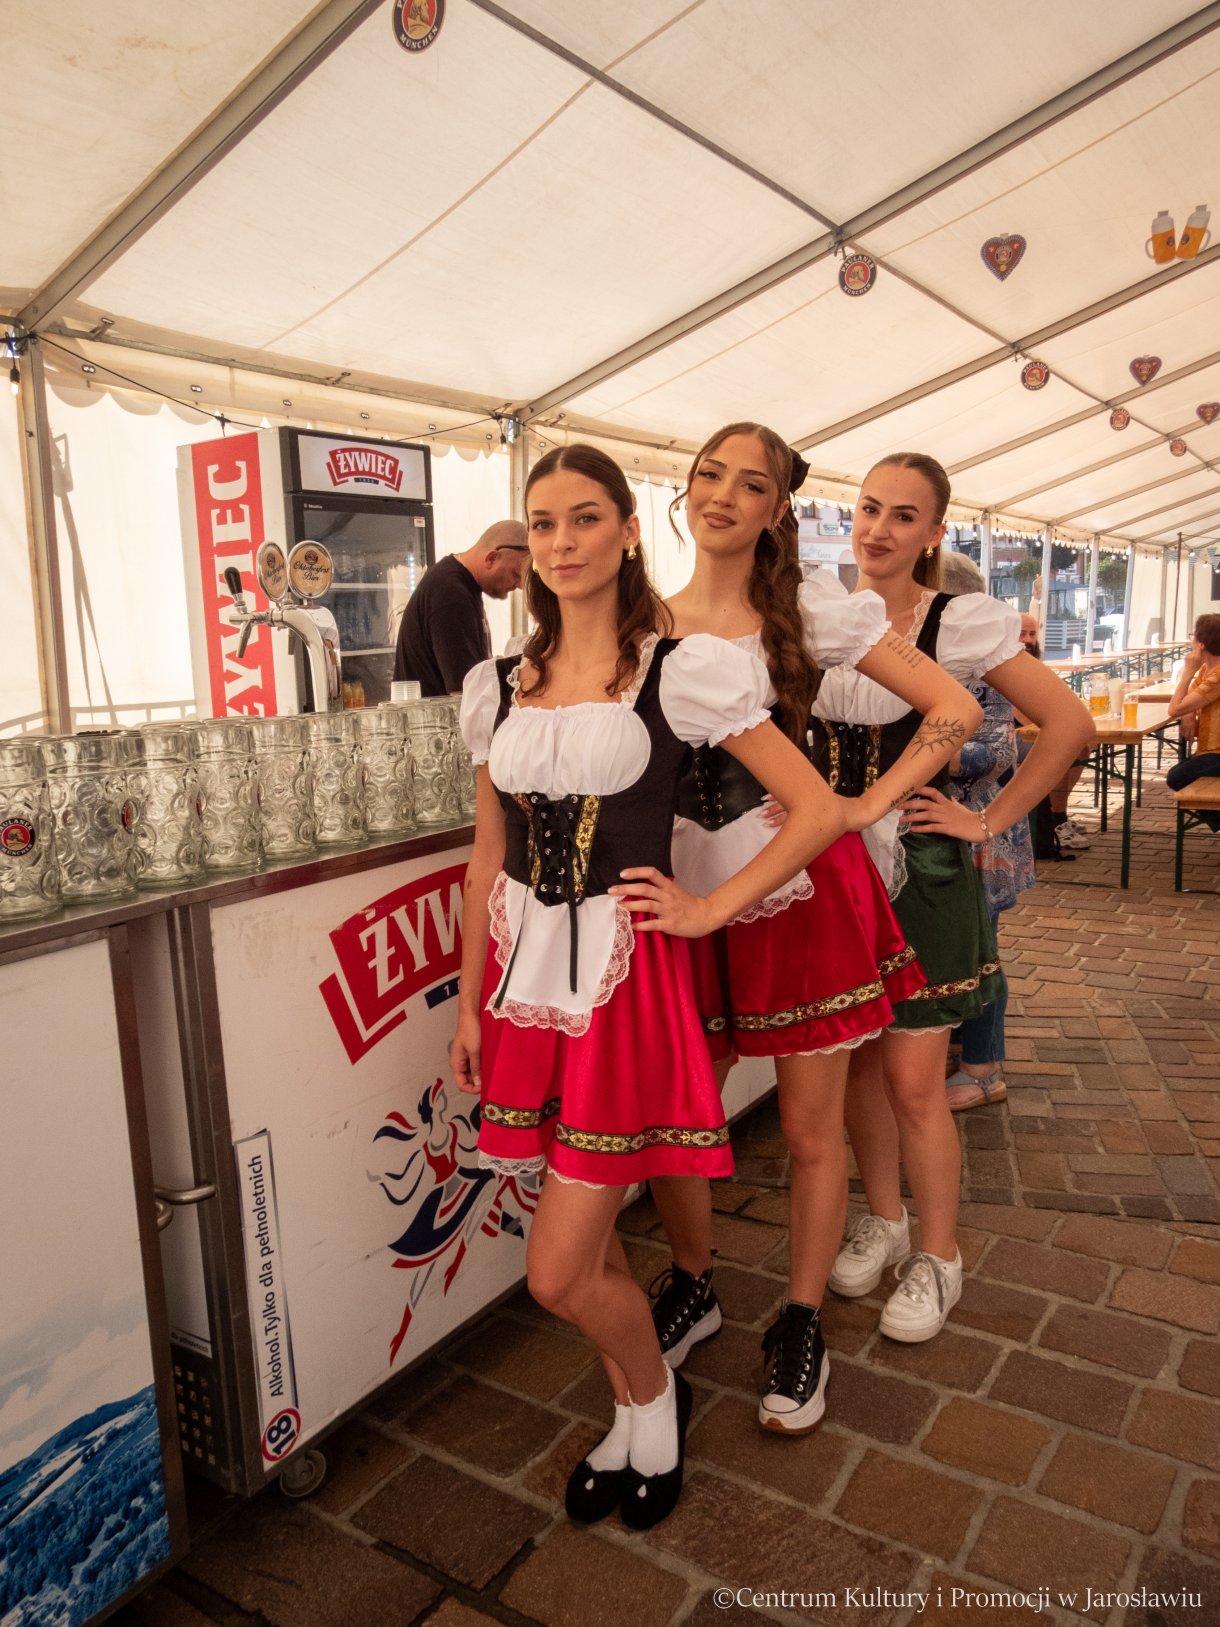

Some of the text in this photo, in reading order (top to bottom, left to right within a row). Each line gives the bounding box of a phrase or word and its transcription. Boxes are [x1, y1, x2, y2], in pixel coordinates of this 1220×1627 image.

[841, 255, 874, 272] PAULANER
[336, 449, 394, 479] ŻYWIEC
[293, 561, 330, 574] Oktoberfest
[303, 571, 320, 581] Bier
[0, 817, 32, 833] AULANER
[358, 882, 464, 999] ŻYW
[248, 1154, 275, 1258] pełnoletnich
[259, 1260, 274, 1288] dla
[267, 1414, 296, 1455] 18
